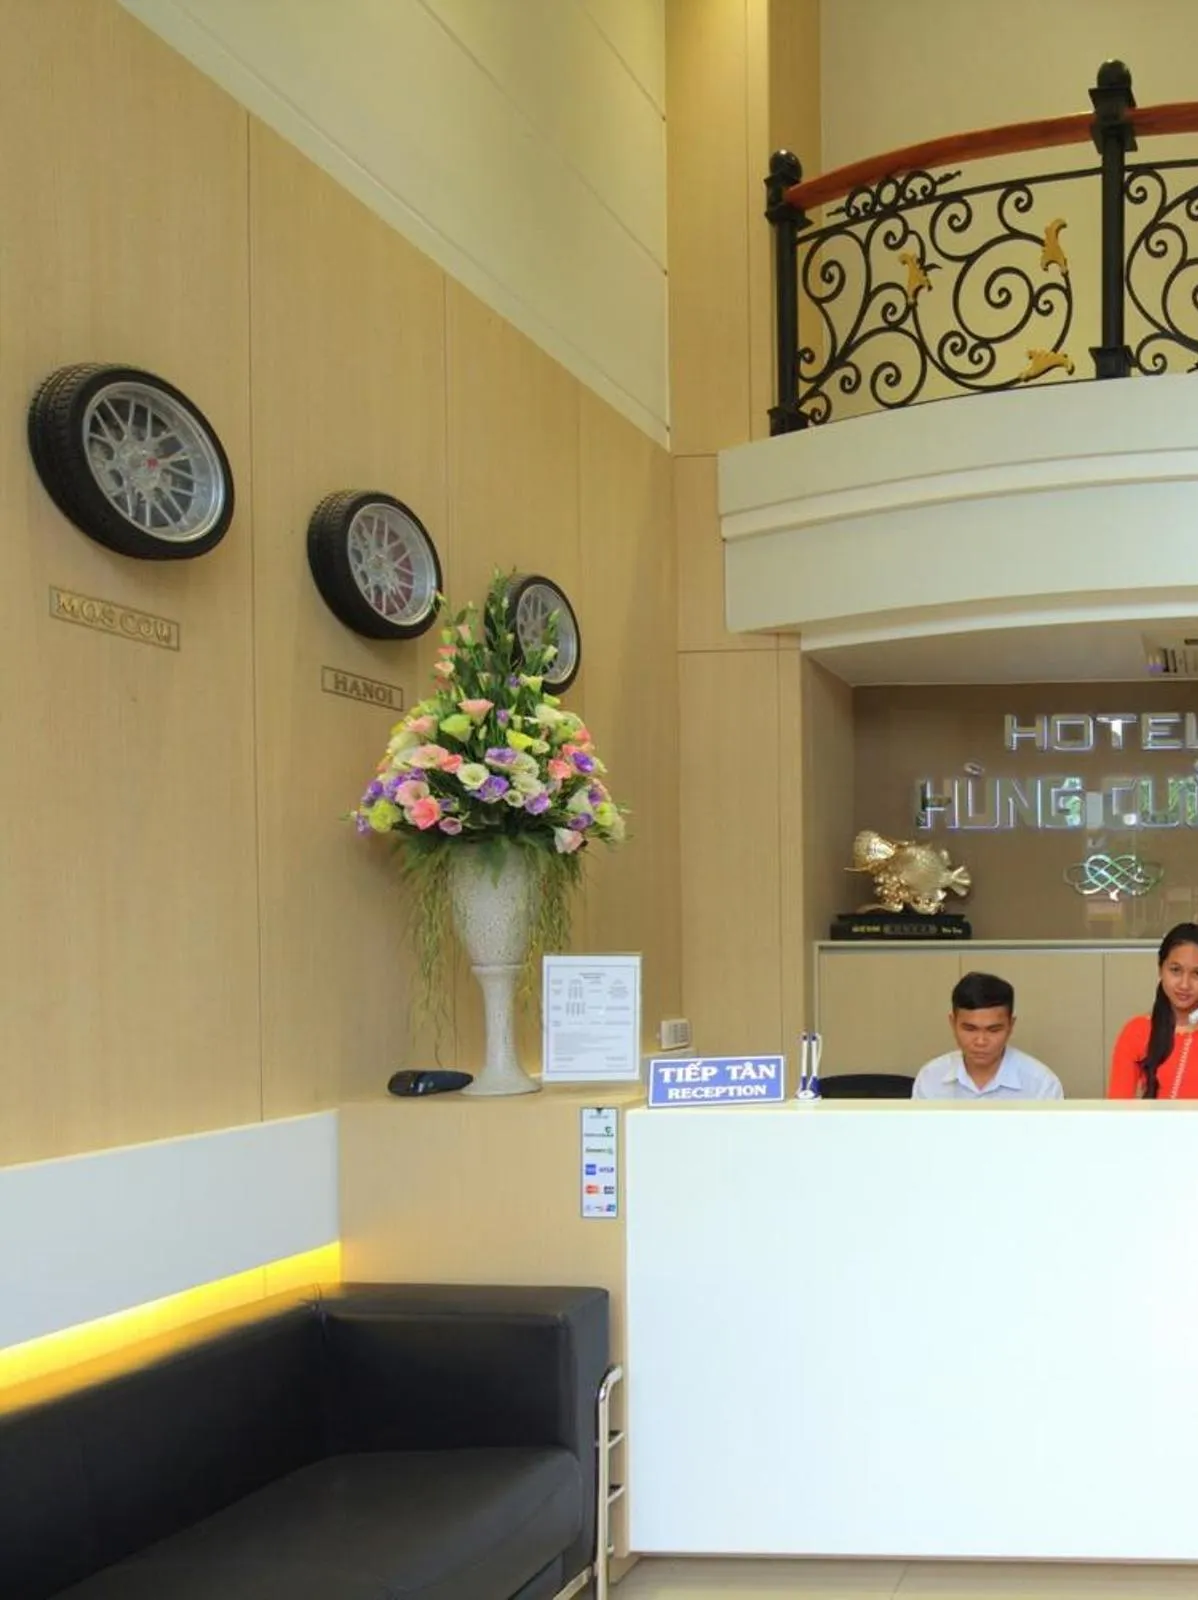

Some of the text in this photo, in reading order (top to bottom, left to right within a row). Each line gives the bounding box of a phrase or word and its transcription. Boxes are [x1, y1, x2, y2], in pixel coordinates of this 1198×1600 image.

[333, 672, 393, 705] HANOI
[658, 1060, 777, 1084] TIẾP TÂN
[667, 1084, 768, 1100] RECEPTION
